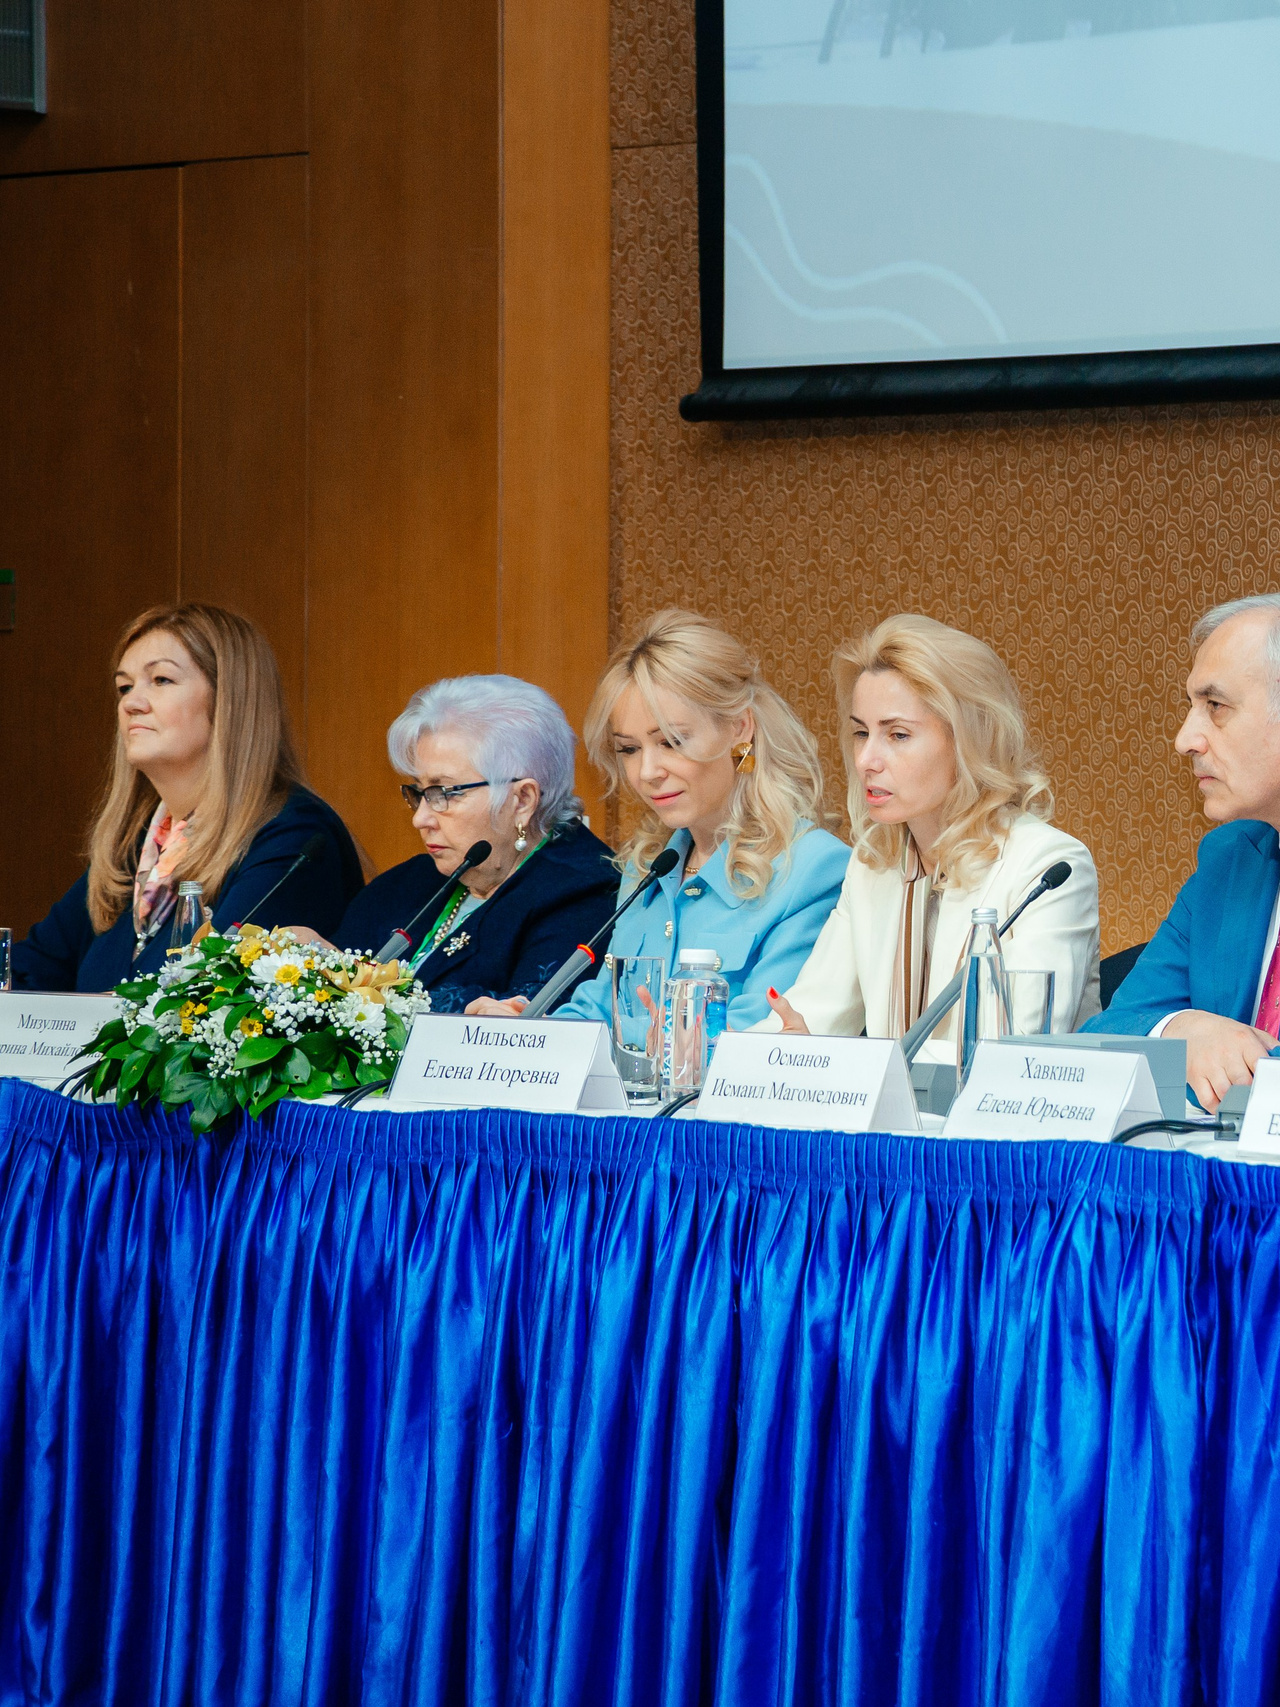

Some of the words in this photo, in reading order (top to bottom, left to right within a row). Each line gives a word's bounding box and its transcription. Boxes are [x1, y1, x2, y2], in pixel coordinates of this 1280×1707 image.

[17, 1013, 77, 1034] Мизулина
[461, 1025, 547, 1049] Мильская
[768, 1046, 831, 1068] Османов
[1021, 1056, 1085, 1082] Хавкина
[423, 1059, 474, 1080] Елена
[478, 1062, 560, 1088] Игоревна
[711, 1078, 766, 1099] Исмаил
[768, 1082, 868, 1106] Магомедович
[976, 1093, 1022, 1115] Елена
[1024, 1096, 1096, 1123] Юрьевна
